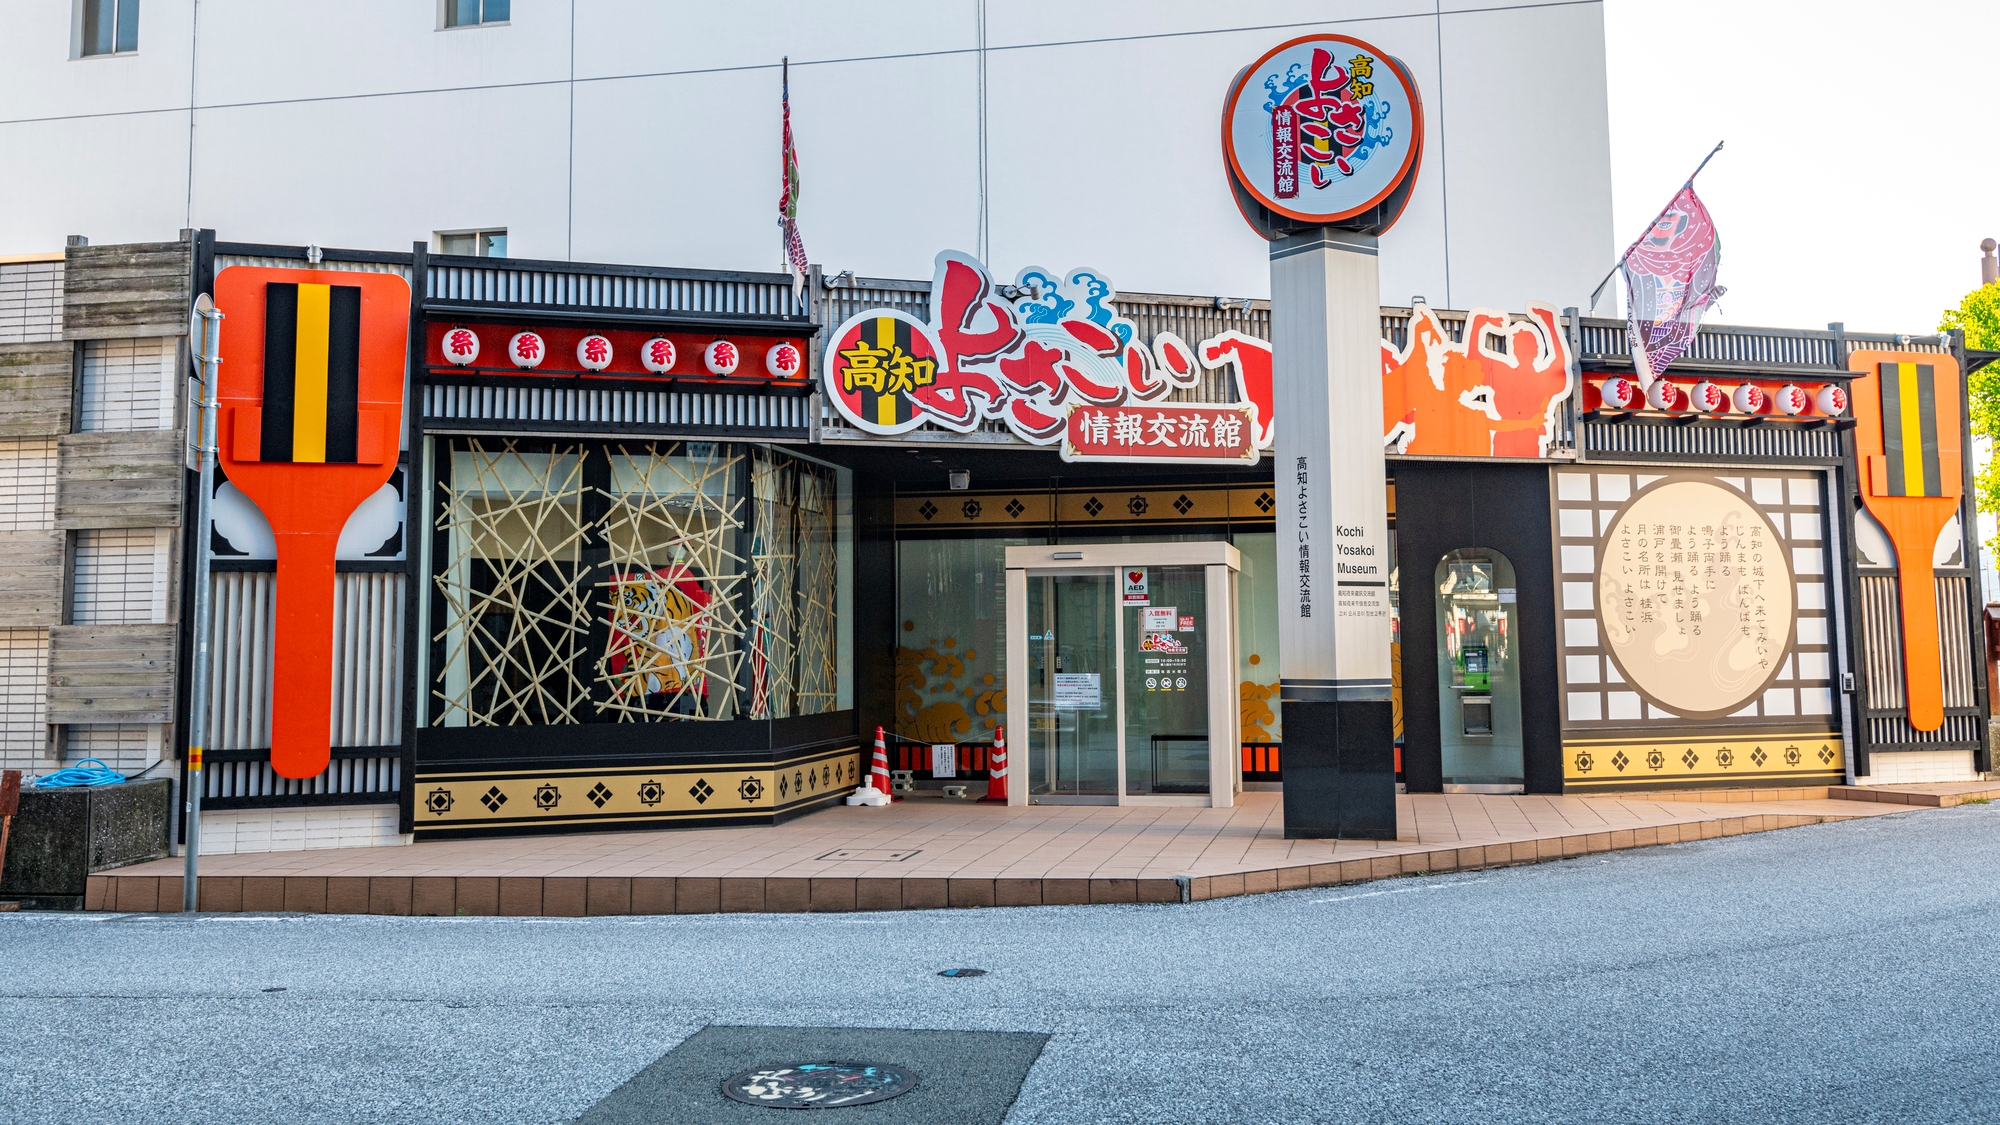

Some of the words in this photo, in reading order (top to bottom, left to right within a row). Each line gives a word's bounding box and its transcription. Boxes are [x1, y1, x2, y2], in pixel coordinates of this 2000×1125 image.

[1349, 54, 1374, 101] 高知
[1293, 48, 1366, 189] よさこい
[1275, 110, 1294, 193] 情報交流館
[450, 329, 474, 356] 祭
[517, 333, 539, 360] 祭
[585, 337, 608, 363] 祭
[650, 339, 672, 365] 祭
[713, 342, 735, 368] 祭
[776, 346, 797, 371] 祭
[840, 340, 937, 395] 高知
[905, 259, 1196, 435] よさこい
[1080, 411, 1242, 449] 情報交流館
[1297, 456, 1311, 618] 高知よさこい情報交流館
[1336, 525, 1364, 538] Kochi
[1336, 544, 1375, 556] Yosakoi
[1337, 563, 1378, 574] Museum
[1653, 524, 1667, 604] 浦戸を開けて
[1702, 525, 1716, 590] 鳴子両手に
[1719, 525, 1731, 577] よう踊る
[1750, 526, 1768, 670] 高知の城下へ来てみいや
